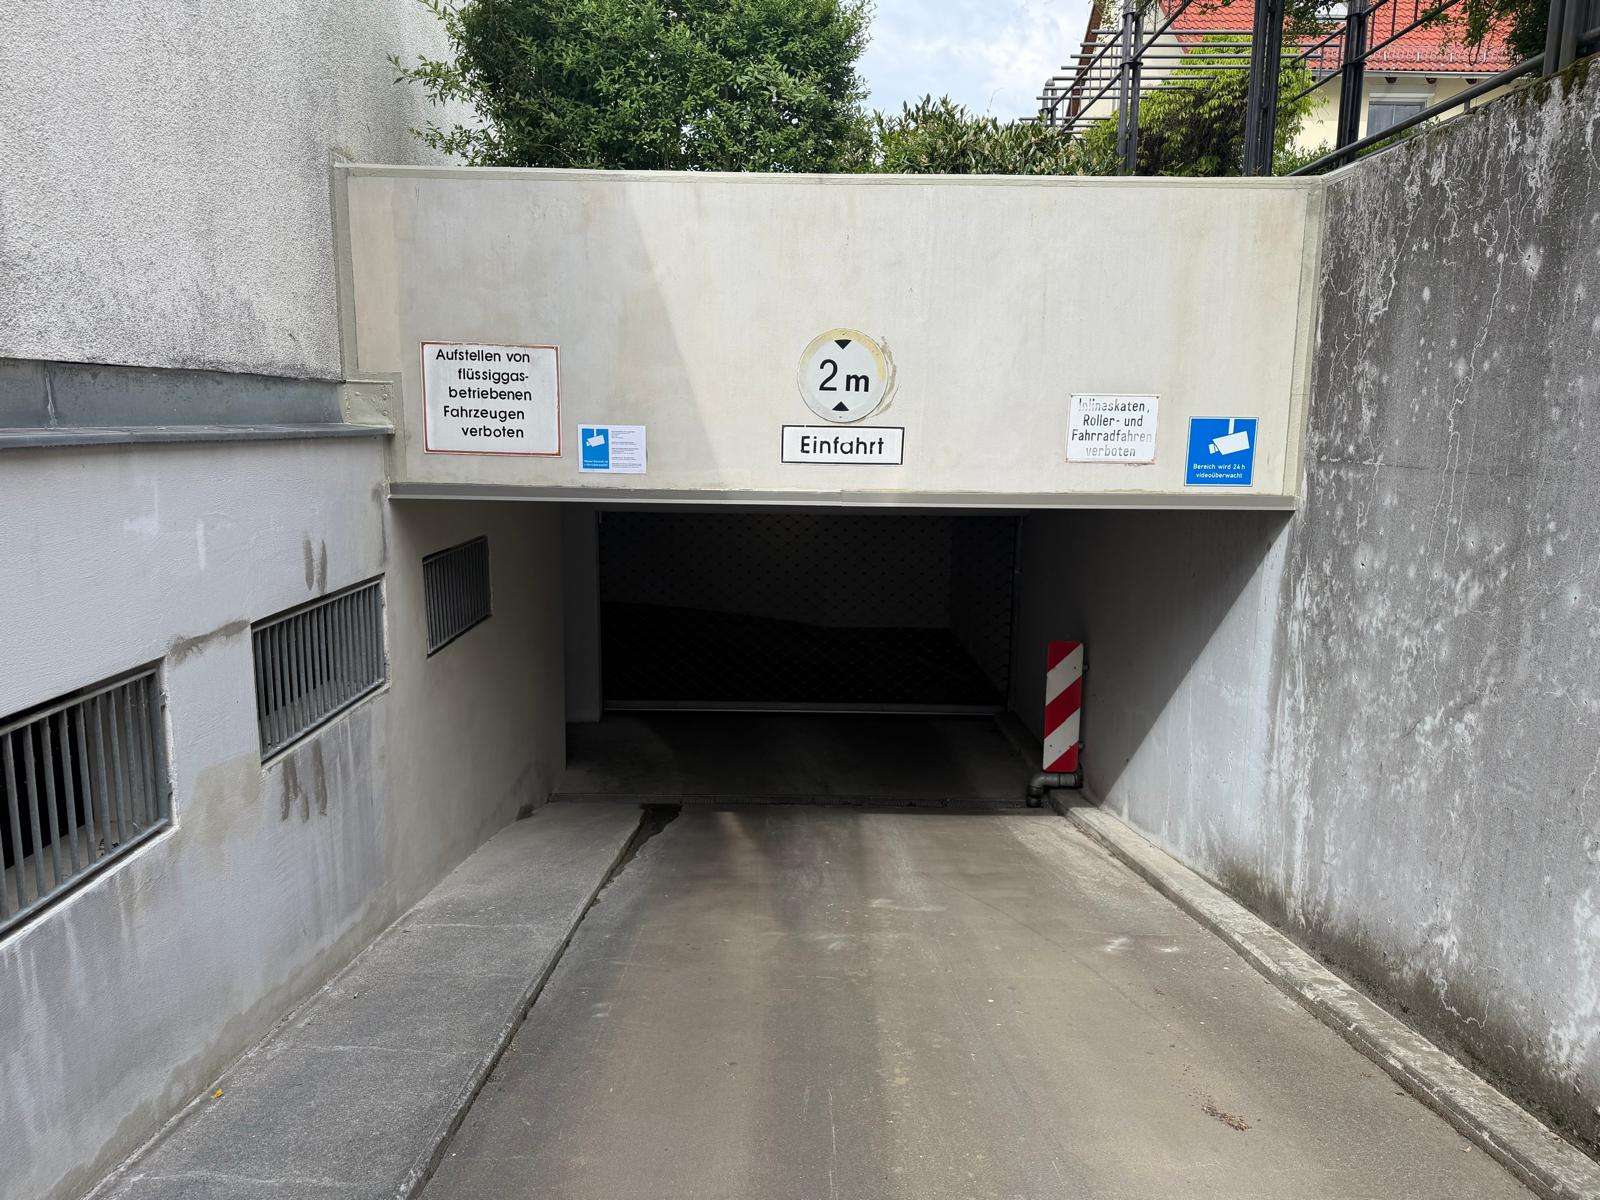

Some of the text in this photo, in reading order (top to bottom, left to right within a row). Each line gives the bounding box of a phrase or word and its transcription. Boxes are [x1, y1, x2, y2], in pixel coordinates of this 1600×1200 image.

[435, 348, 530, 363] Aufstellen von
[458, 368, 529, 385] flüssiggas-
[819, 359, 870, 393] 2 m
[448, 386, 532, 401] betriebenen
[443, 405, 525, 422] Fahrzeugen
[1083, 413, 1144, 427] Roller- und
[461, 425, 525, 438] verboten
[1071, 428, 1152, 443] Fahrradfahren
[800, 435, 885, 455] Einfahrt
[1085, 445, 1136, 457] verboten
